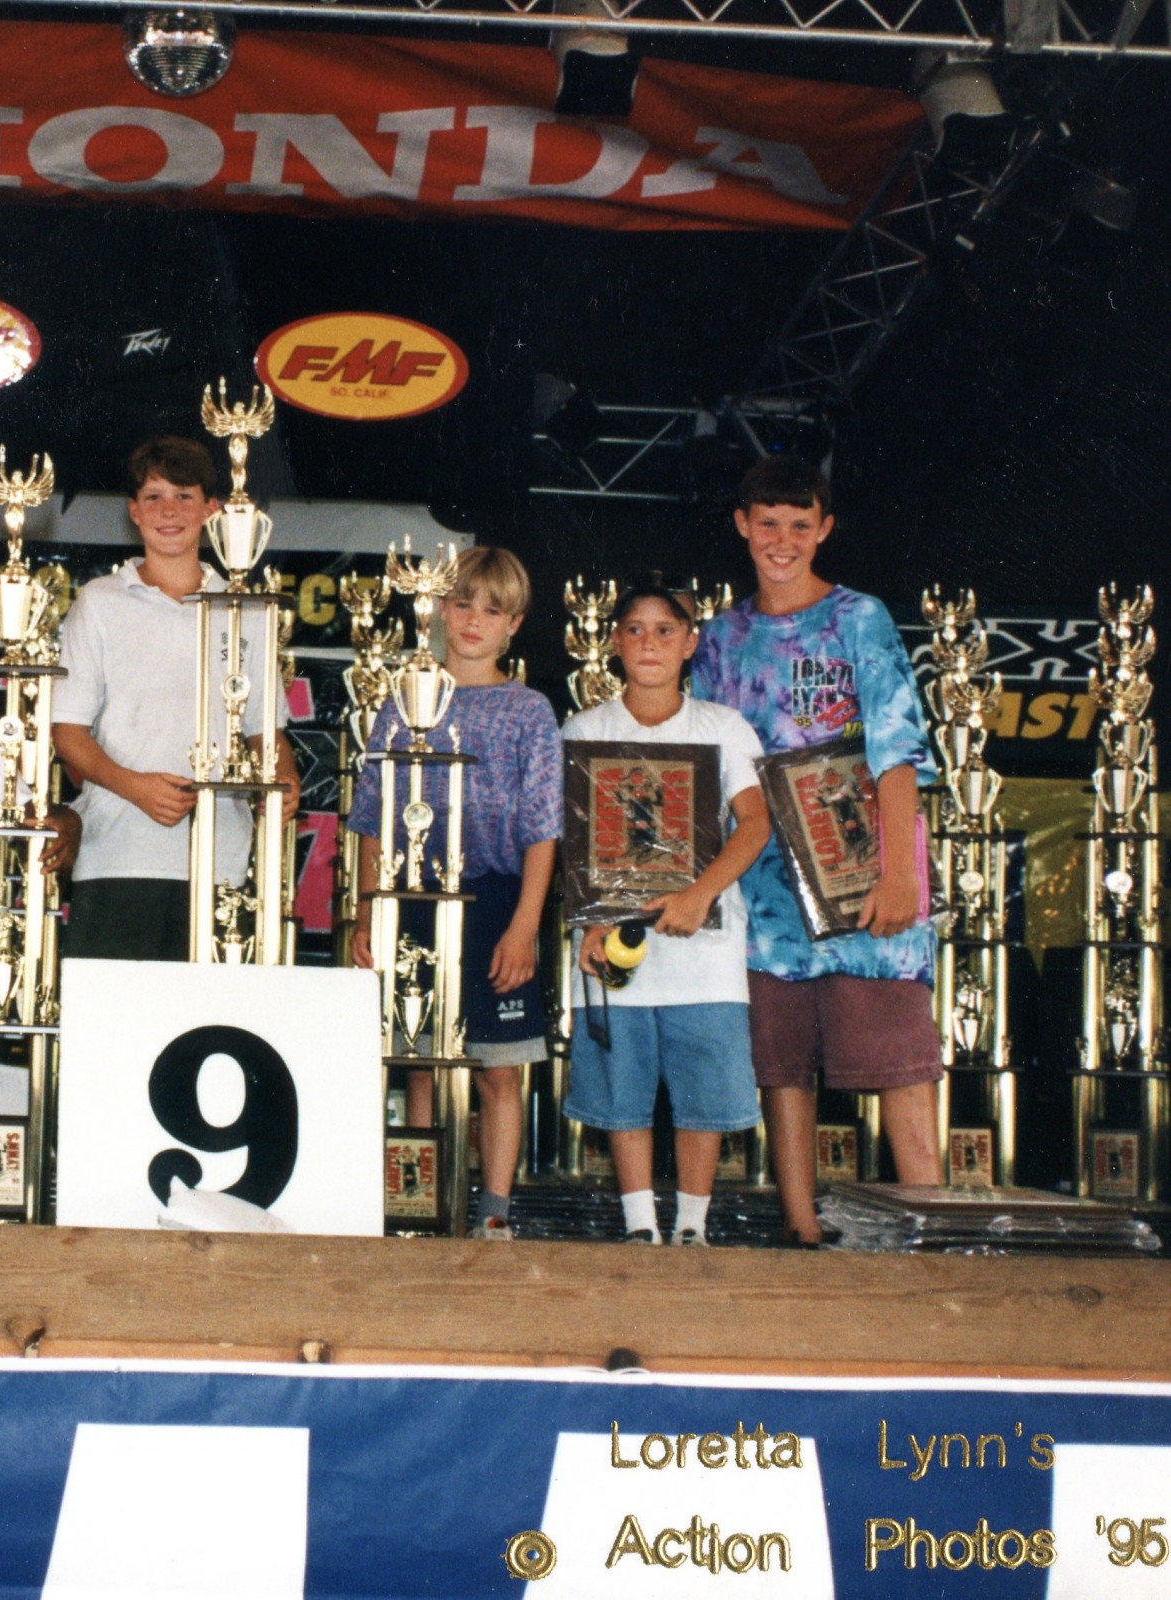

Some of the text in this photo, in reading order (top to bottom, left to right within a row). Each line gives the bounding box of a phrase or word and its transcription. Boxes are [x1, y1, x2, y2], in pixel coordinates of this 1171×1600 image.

[278, 338, 447, 387] FMF
[596, 767, 625, 859] LORETTA
[661, 769, 690, 840] LYNN'S
[795, 771, 845, 869] LORETTA
[147, 1025, 300, 1210] 9
